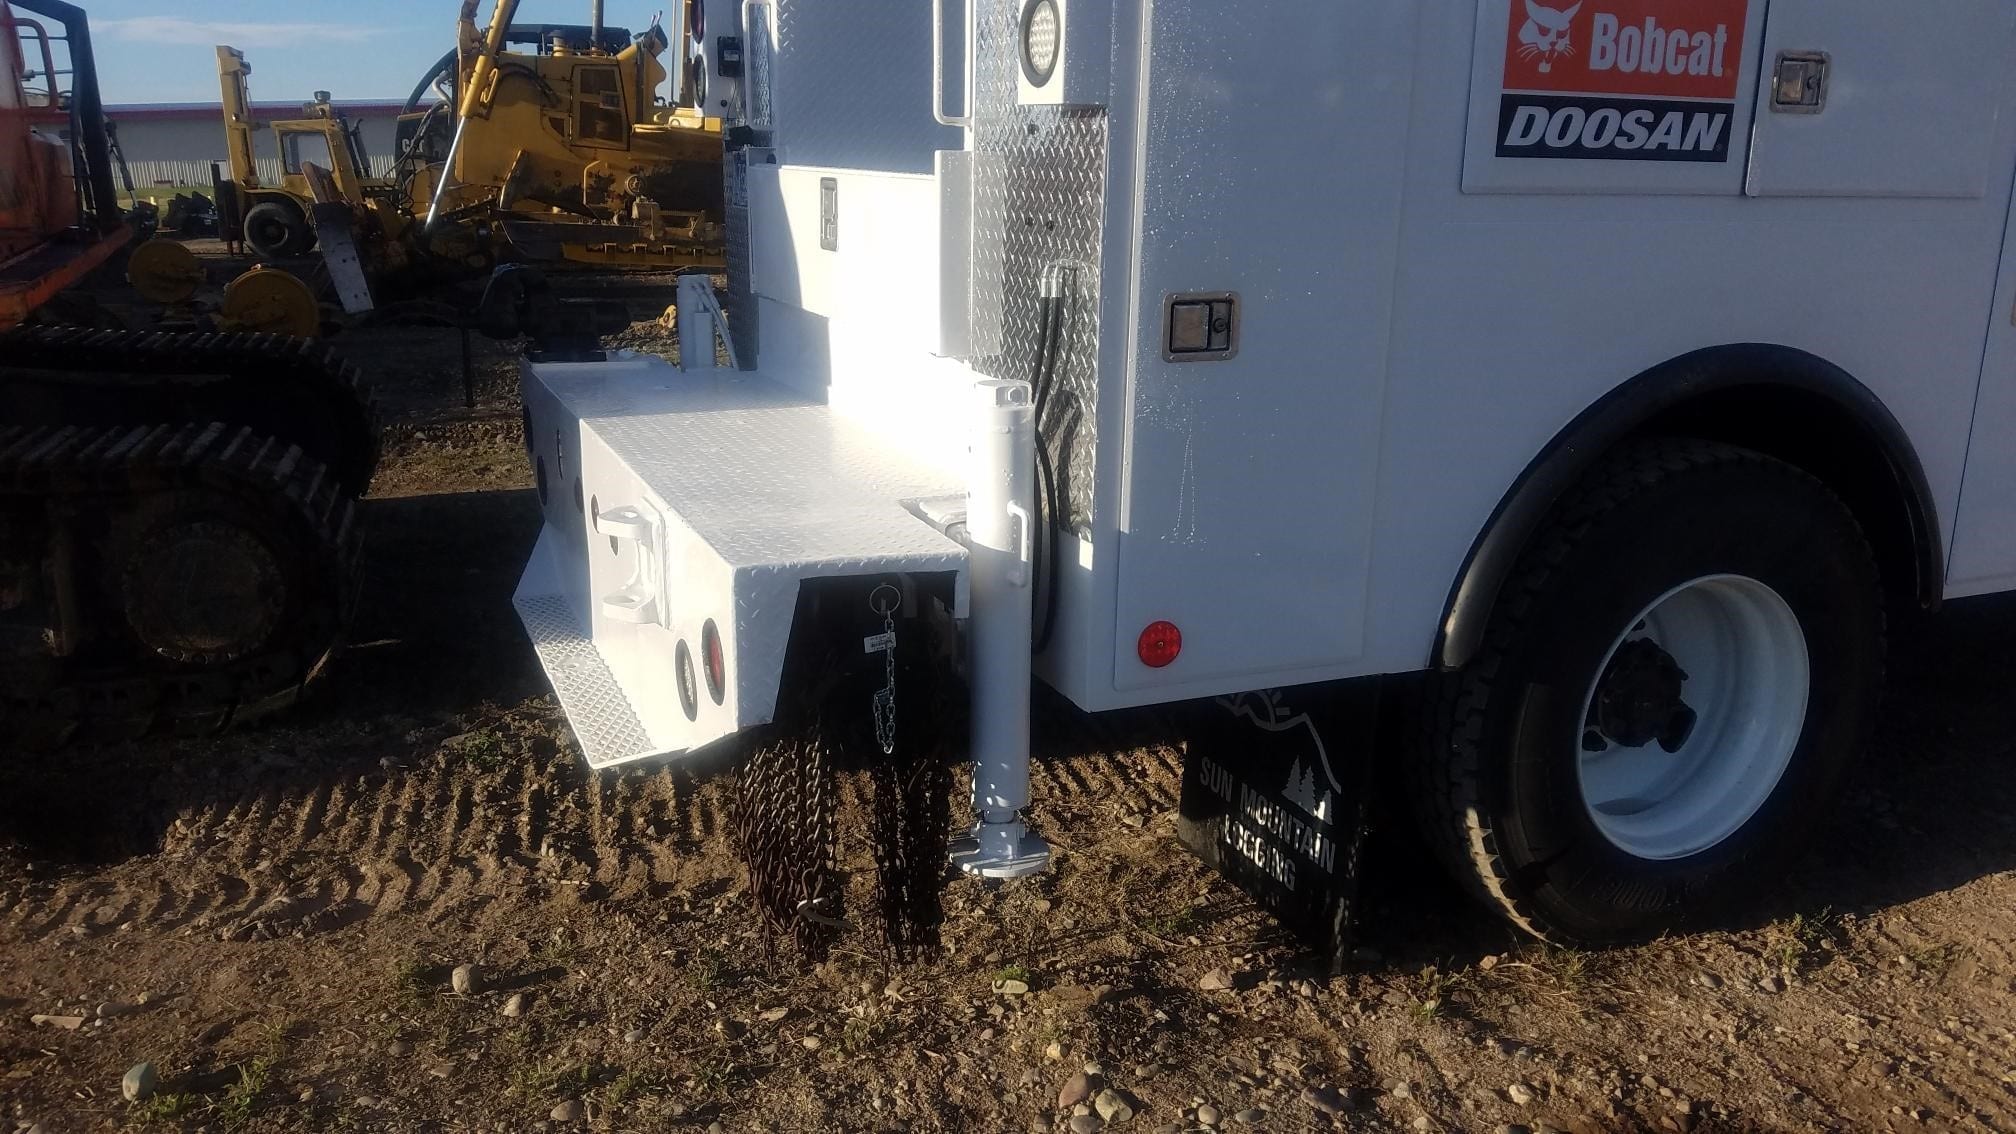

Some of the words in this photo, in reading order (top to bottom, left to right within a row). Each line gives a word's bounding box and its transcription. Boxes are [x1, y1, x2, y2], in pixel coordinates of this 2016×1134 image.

[1589, 13, 1727, 77] Bobcat
[1504, 105, 1727, 151] DOOSAN
[1200, 756, 1234, 803] SUN
[1239, 782, 1336, 874] MOUNTAIN
[1224, 813, 1296, 891] LOGGING
